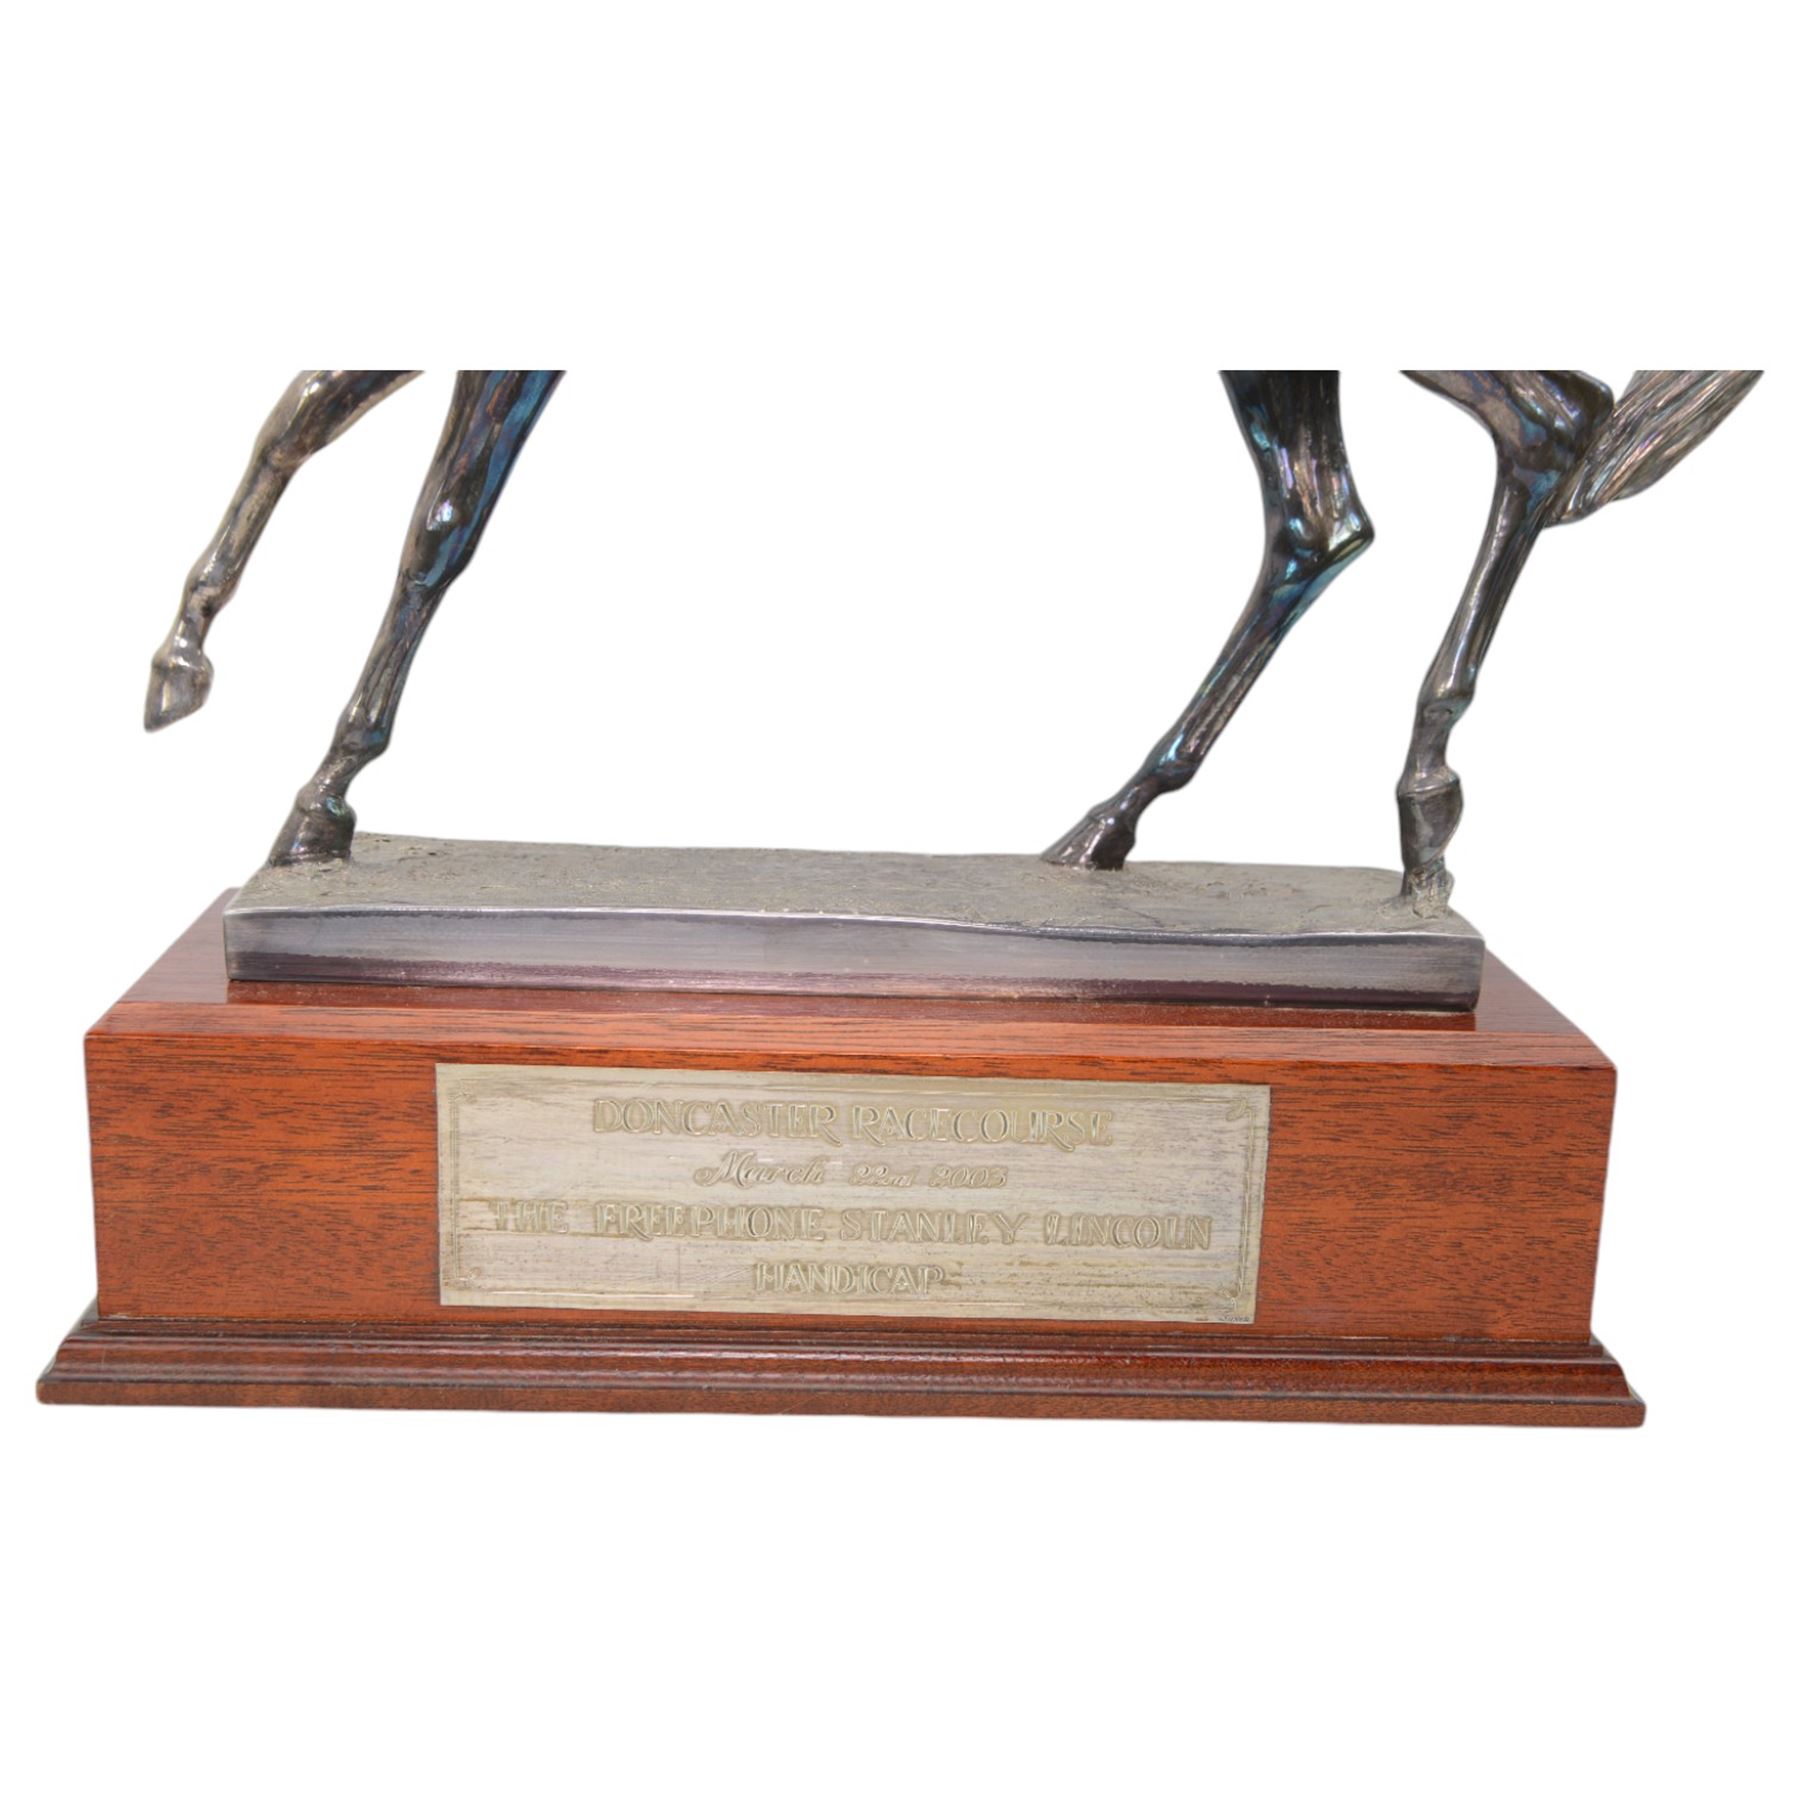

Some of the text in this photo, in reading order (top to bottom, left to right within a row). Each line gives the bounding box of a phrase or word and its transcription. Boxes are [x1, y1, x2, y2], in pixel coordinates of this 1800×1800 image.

[594, 1098, 1114, 1152] DONCASTER RACECOURSE
[693, 1151, 829, 1189] March
[489, 1200, 1213, 1249] THE FREEPHONE STANLEY LINCOLN
[755, 1261, 944, 1295] HANDICAP
